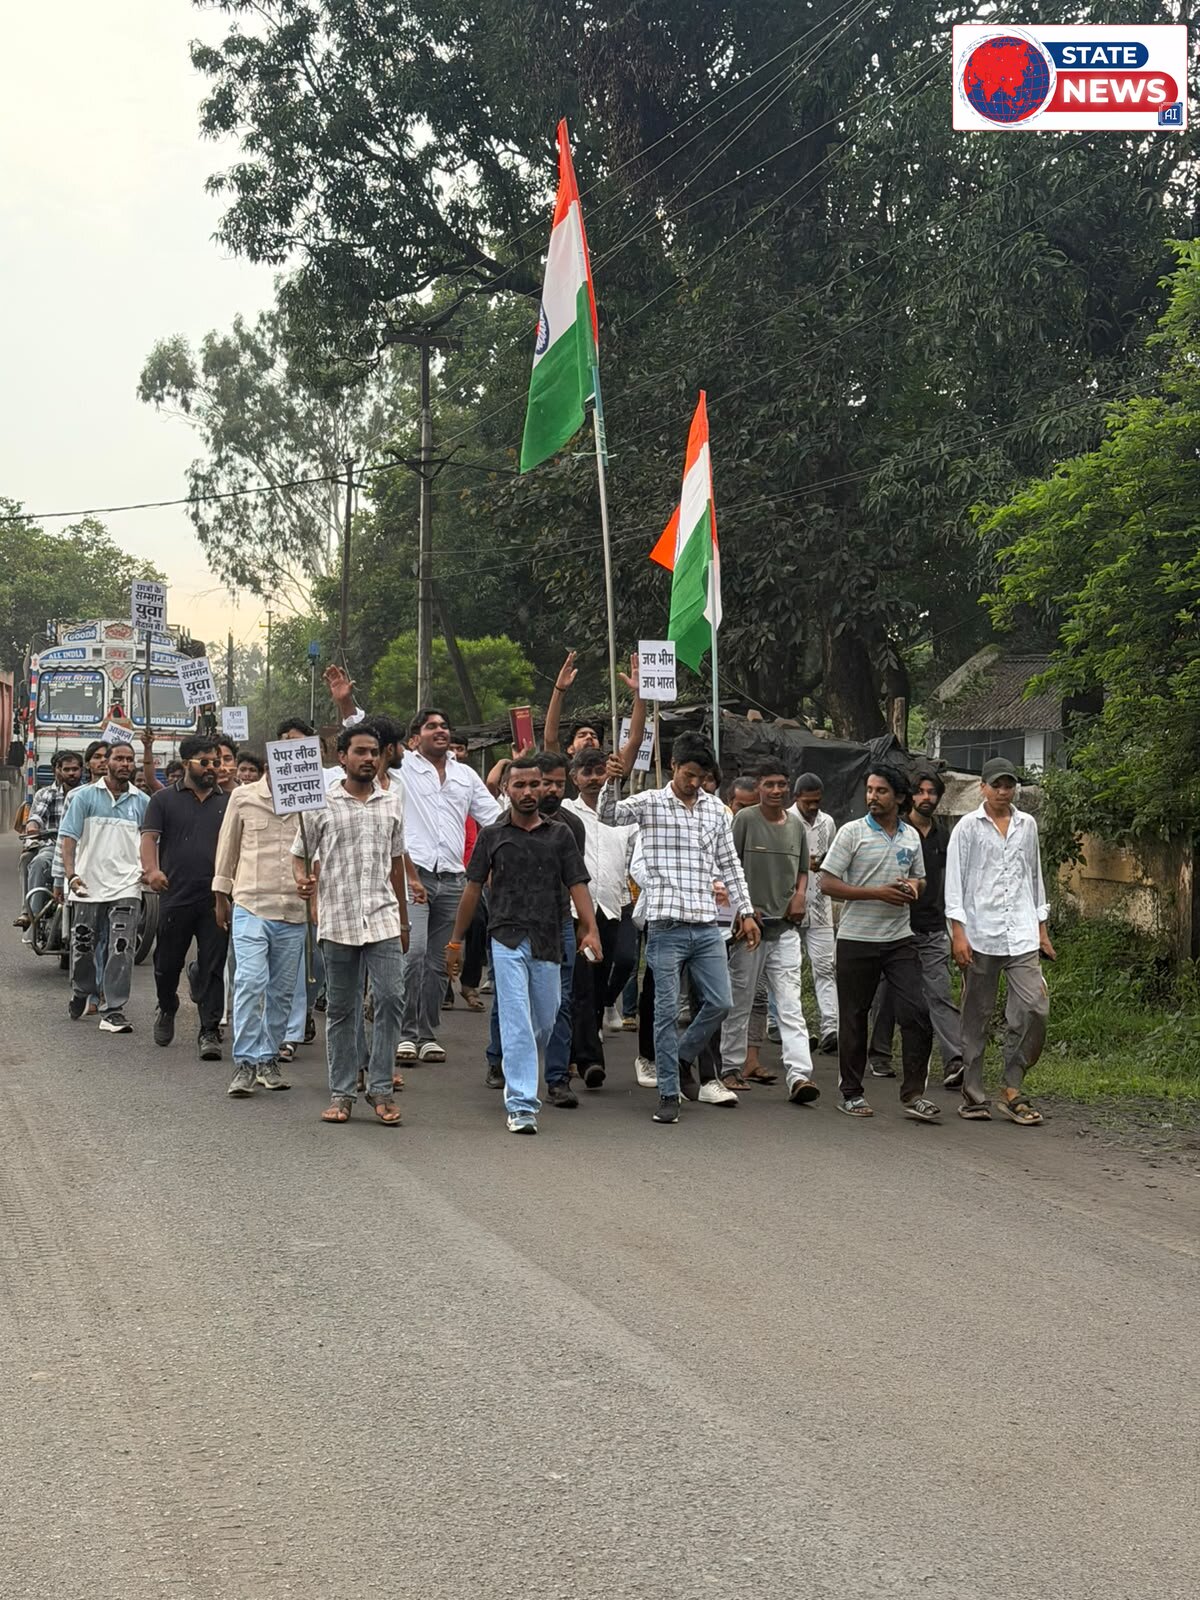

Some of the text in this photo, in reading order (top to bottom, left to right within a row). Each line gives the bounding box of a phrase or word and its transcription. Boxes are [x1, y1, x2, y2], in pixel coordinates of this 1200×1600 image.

[135, 591, 164, 604] सम्मान
[135, 603, 163, 619] युवा
[69, 629, 96, 640] GOODS
[63, 649, 84, 658] INDIA
[154, 652, 182, 663] PERM
[642, 648, 674, 666] जय भीम
[181, 667, 209, 680] सम्मान
[185, 678, 210, 696] युवा
[642, 676, 675, 689] जय भारत
[272, 745, 317, 761] पेपर लीक
[638, 750, 650, 761] ारत
[276, 761, 319, 775] नहीं चलेगा
[277, 779, 320, 794] भ्रष्टाचार
[280, 792, 322, 807] नहीं चलेगा
